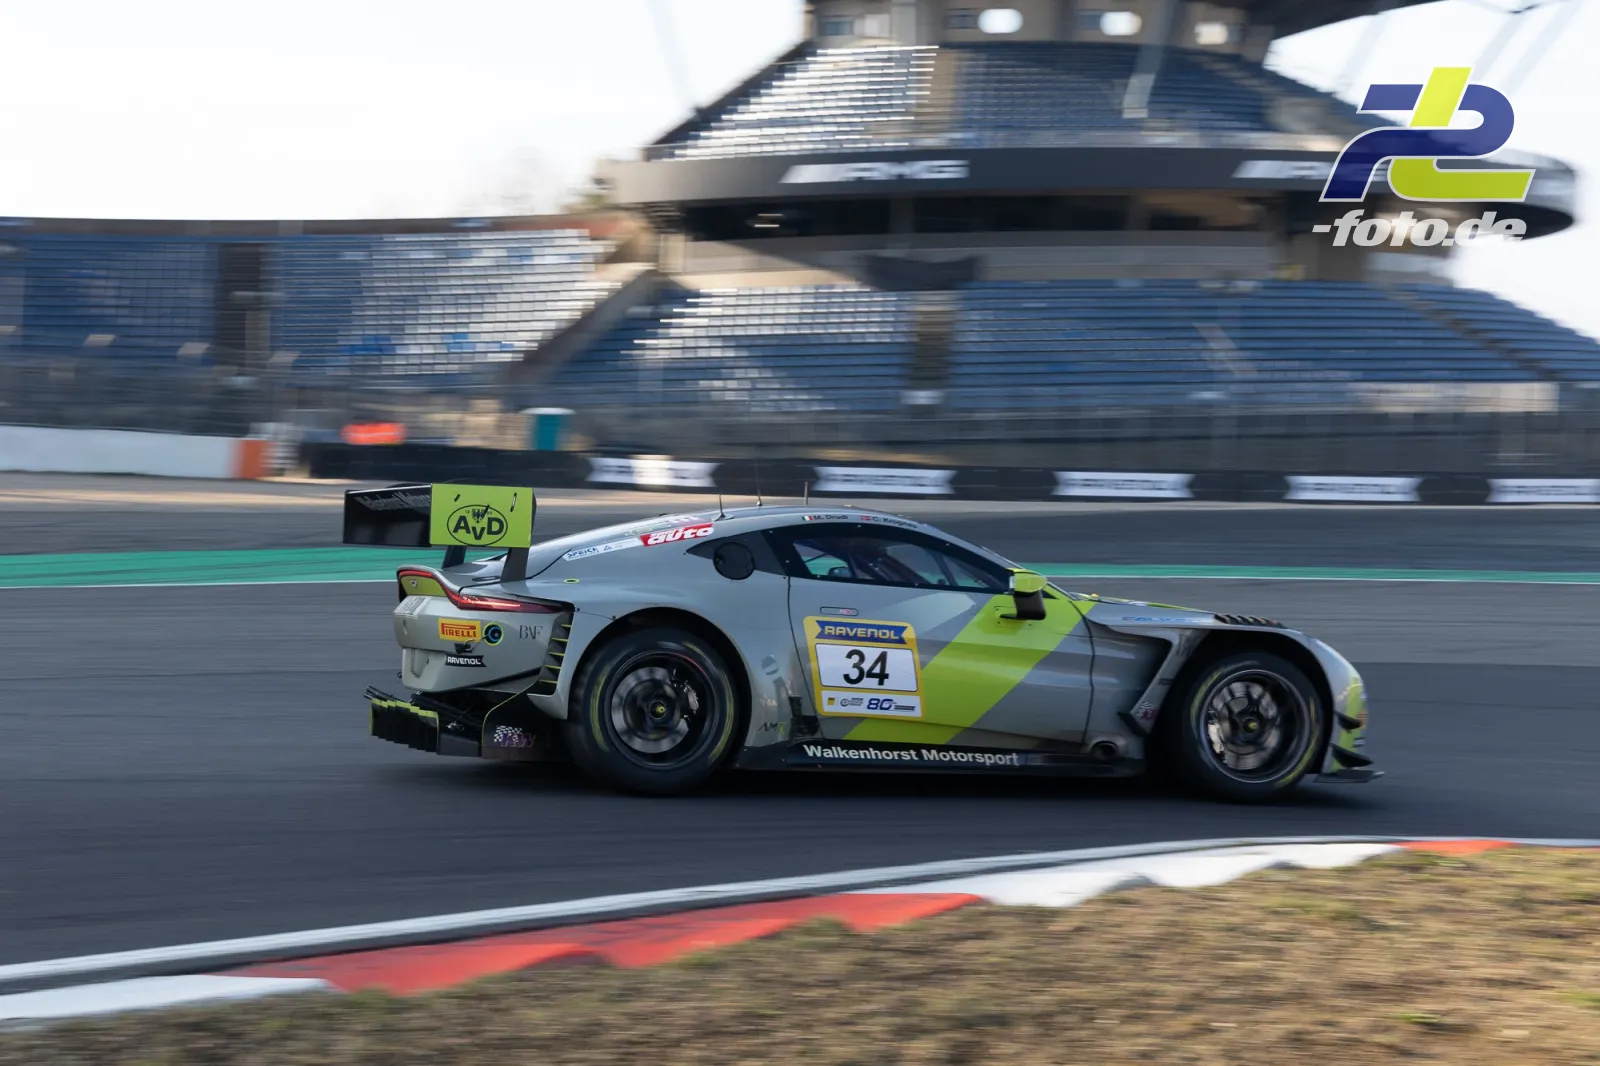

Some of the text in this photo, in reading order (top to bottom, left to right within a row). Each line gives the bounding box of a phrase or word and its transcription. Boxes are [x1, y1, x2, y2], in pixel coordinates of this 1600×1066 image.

[647, 525, 715, 545] auto
[441, 623, 477, 638] PIRELLI
[824, 625, 899, 639] RAVENOL
[447, 656, 481, 665] RAVENOL
[843, 649, 889, 686] 34
[803, 744, 1020, 766] Walkenhorst Motorsport
